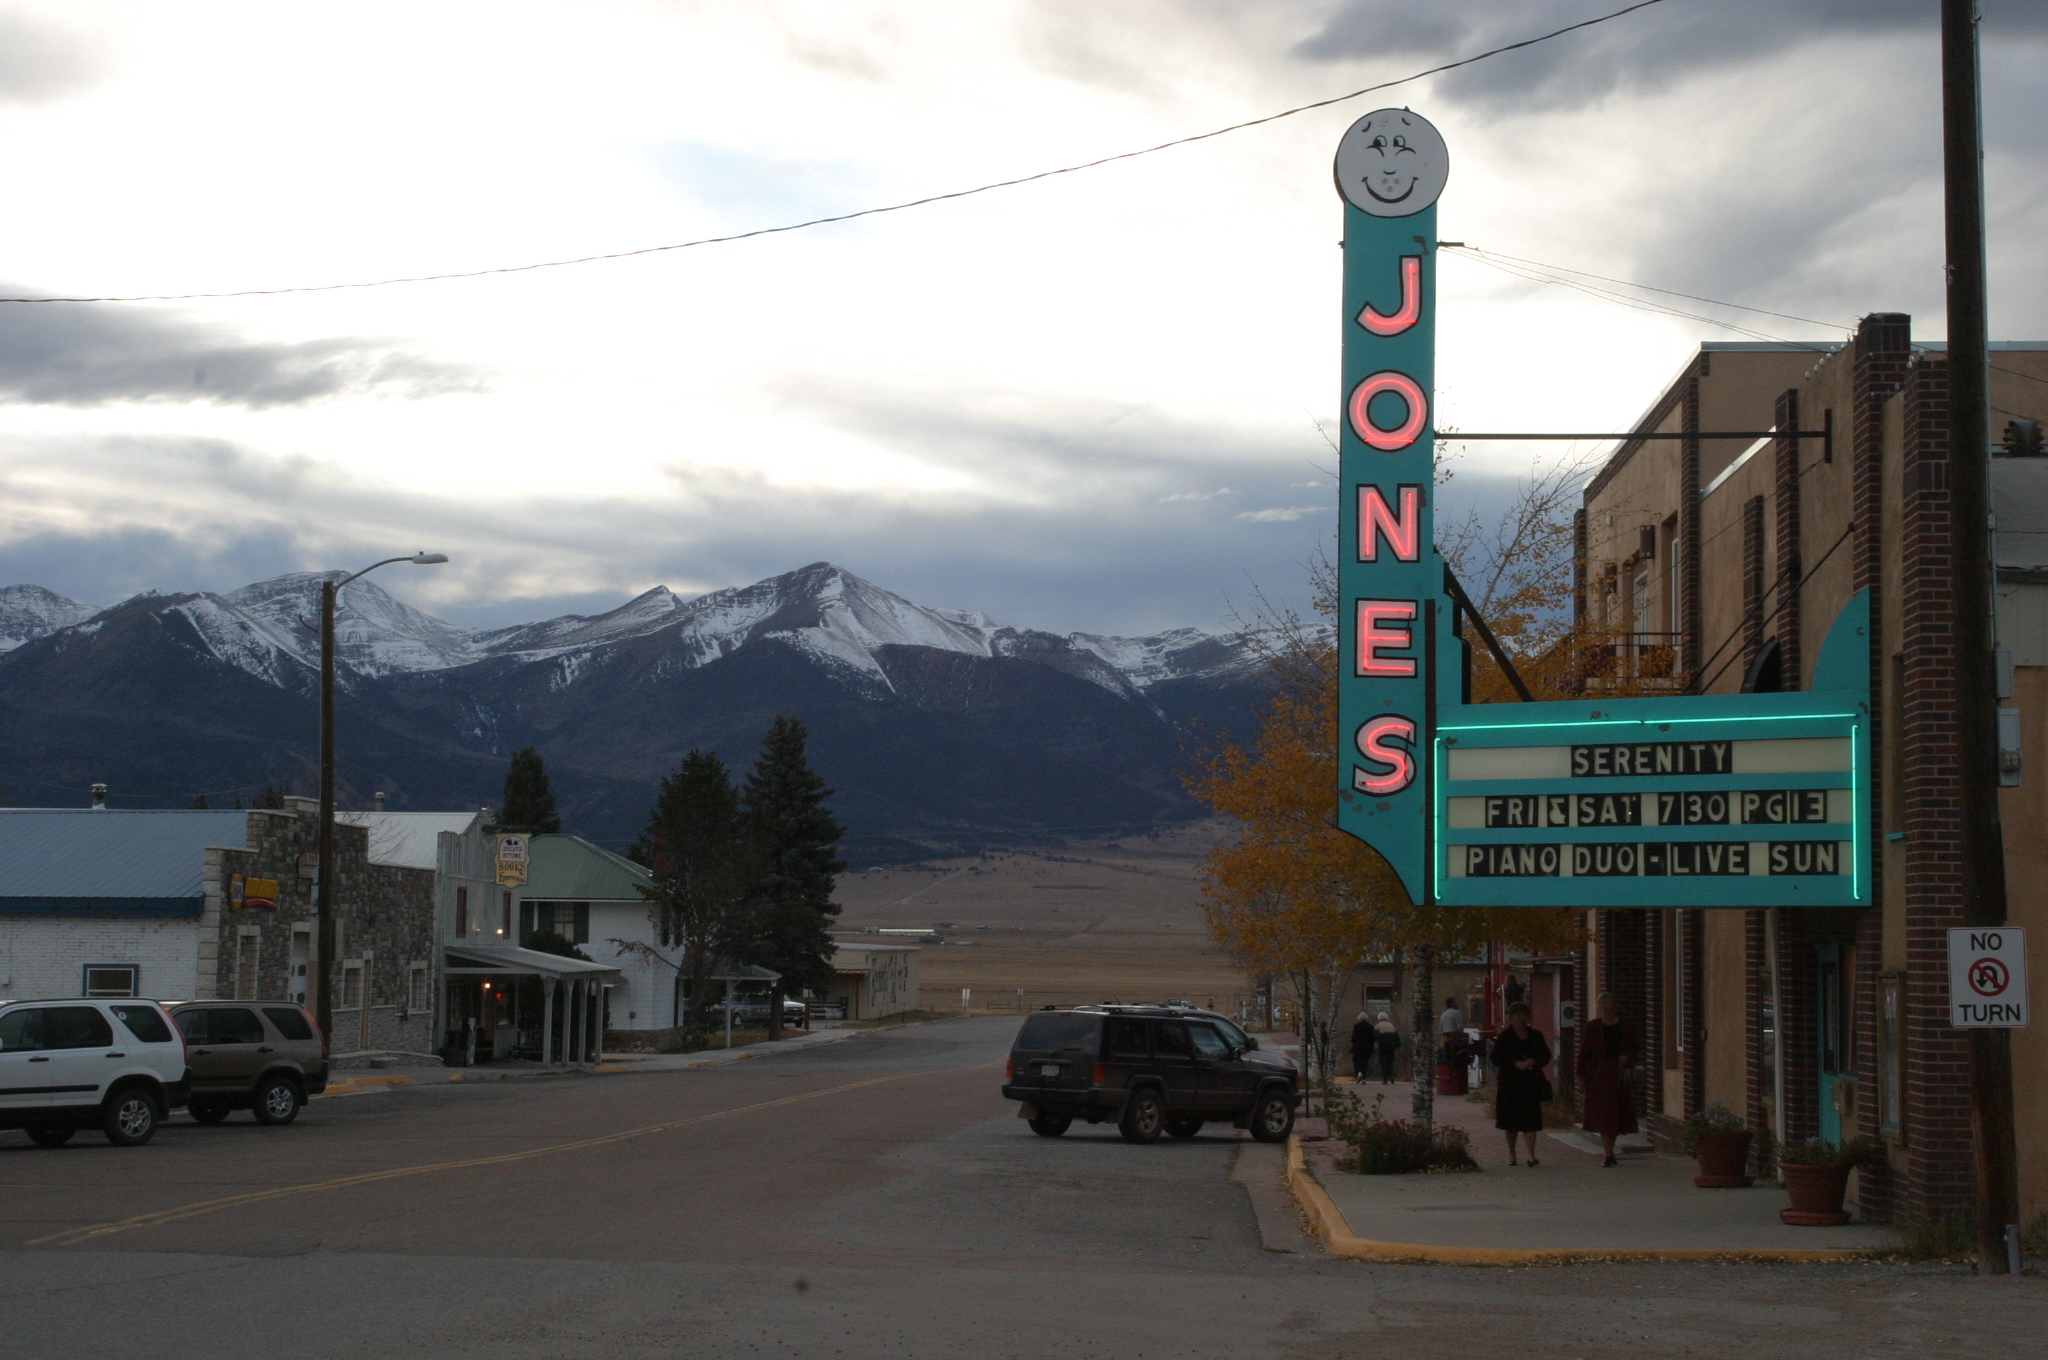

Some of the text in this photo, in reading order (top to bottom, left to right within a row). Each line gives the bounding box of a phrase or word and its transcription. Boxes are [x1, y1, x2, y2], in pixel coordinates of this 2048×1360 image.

[1347, 255, 1429, 797] JONES
[1573, 743, 1729, 776] SERENITY
[1487, 799, 1535, 826] FRI
[1579, 796, 1636, 825] SAT
[1659, 796, 1726, 824] 730
[498, 862, 526, 875] BOOKS
[1468, 847, 1557, 875] PIANO
[1574, 845, 1634, 874] DUO
[1672, 844, 1746, 874] LIVE
[1770, 844, 1834, 873] SUN
[1970, 932, 2003, 951] NO
[1958, 1003, 2021, 1022] TURN
